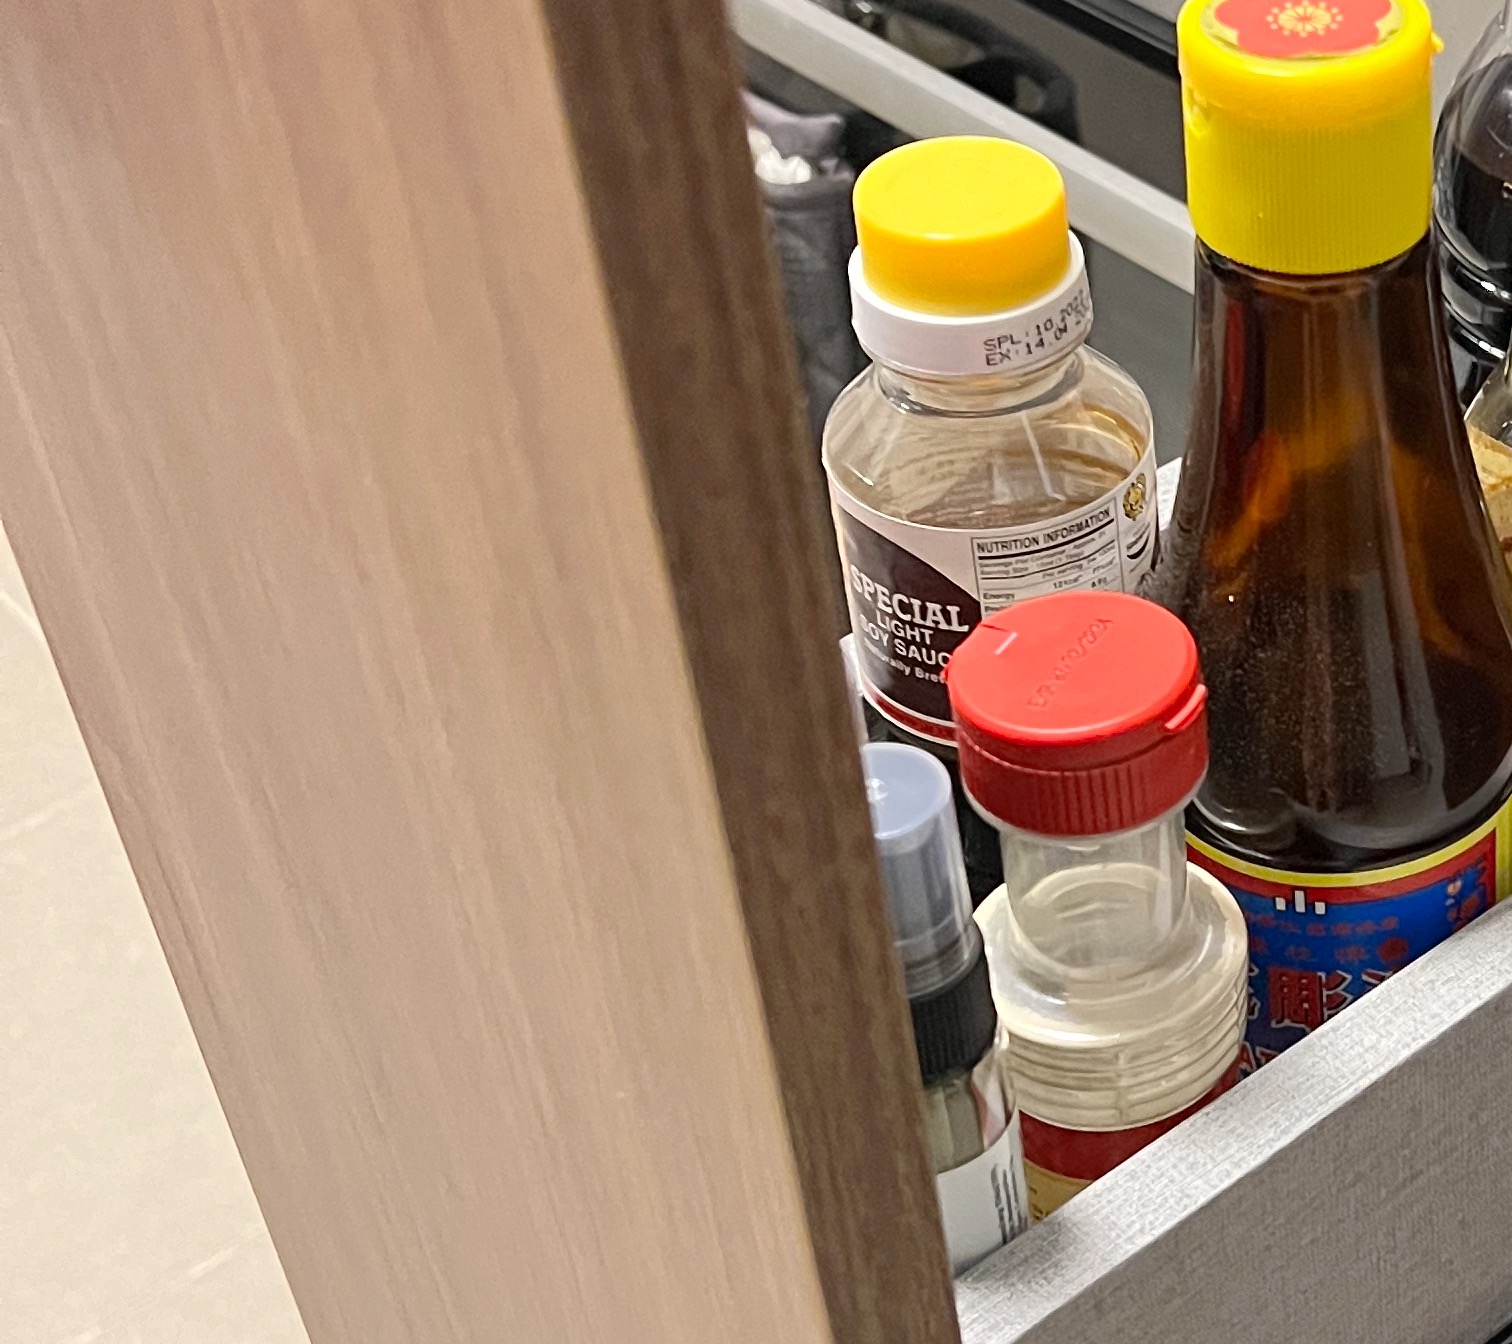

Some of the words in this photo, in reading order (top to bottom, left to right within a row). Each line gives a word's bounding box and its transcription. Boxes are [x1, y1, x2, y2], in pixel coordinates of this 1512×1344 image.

[976, 536, 1040, 554] NUTRITION
[1043, 507, 1111, 544] INFORMATION
[850, 563, 970, 632] SPECIAL
[876, 609, 934, 645] LIGHT
[893, 639, 953, 668] SAUC
